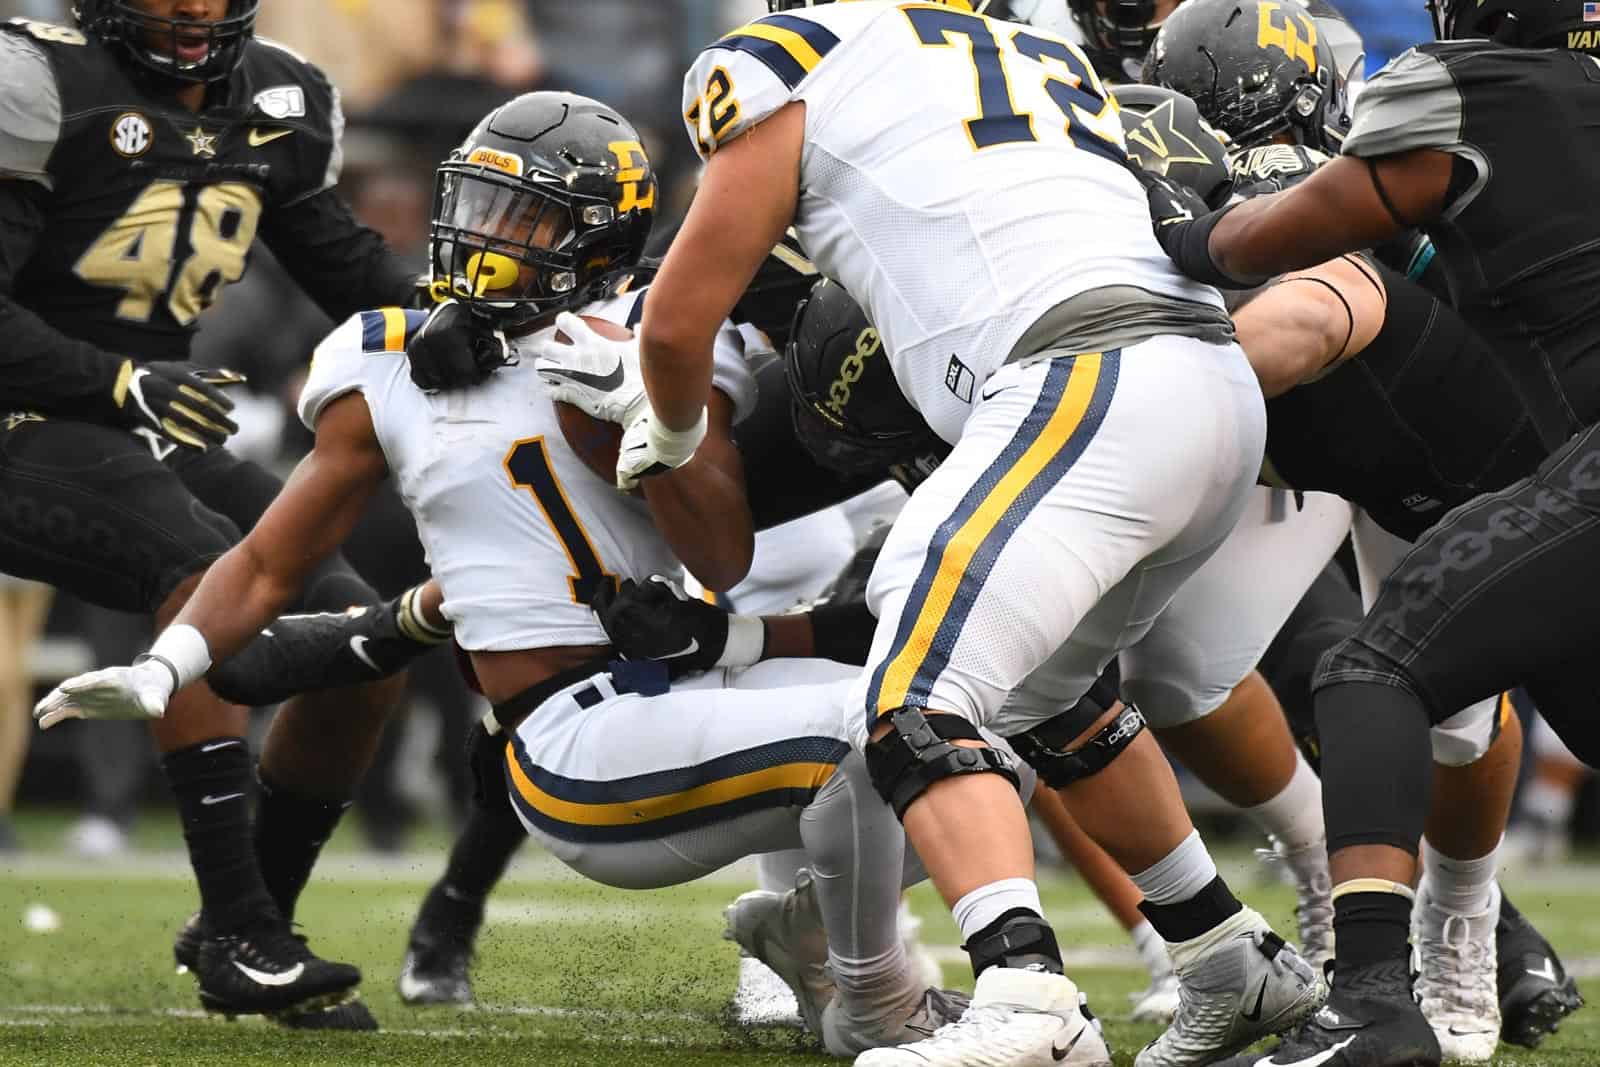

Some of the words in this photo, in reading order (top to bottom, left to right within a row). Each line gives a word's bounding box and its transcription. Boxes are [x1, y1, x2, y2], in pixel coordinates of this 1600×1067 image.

[897, 3, 1130, 164] 72
[1127, 119, 1169, 158] V
[478, 151, 512, 168] BUCS
[71, 178, 263, 327] 48
[502, 434, 621, 607] 1
